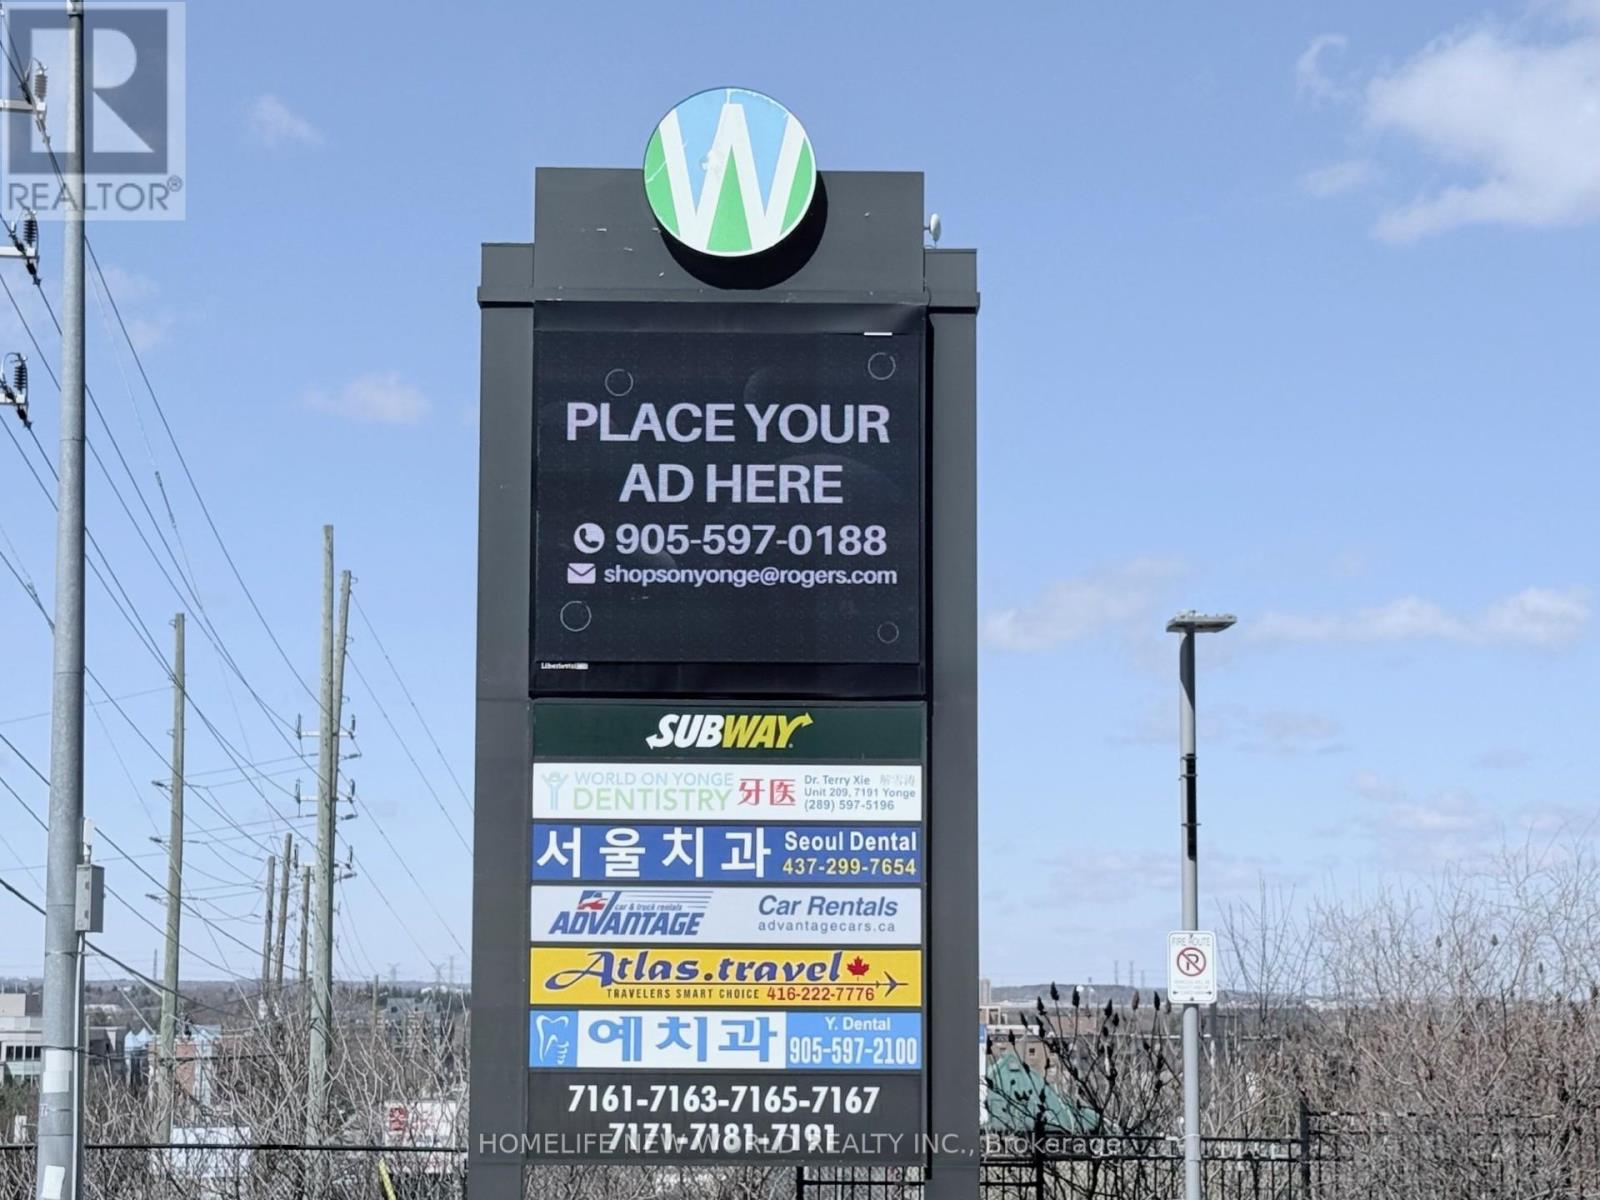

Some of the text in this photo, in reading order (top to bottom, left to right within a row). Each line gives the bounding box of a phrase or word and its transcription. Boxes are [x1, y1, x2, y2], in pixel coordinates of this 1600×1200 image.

[657, 102, 807, 255] W
[566, 402, 891, 444] PLACE YOUR
[619, 463, 844, 504] AD HERE
[615, 523, 888, 556] 905-597-0188
[603, 565, 898, 588] shopsonyonge@rogers.com
[645, 712, 813, 750] SUBWAY
[574, 772, 734, 787] WORLD ON YONGE
[737, 778, 796, 807] 牙医
[804, 774, 871, 787] Dr. Terry Xie
[572, 788, 732, 812] DENTISTRY
[804, 787, 916, 799] Unit 209, 7191 Yonge
[804, 799, 895, 812] (289) 597-5196
[536, 827, 772, 879] 서울치과
[784, 830, 917, 853] Seoul Dental
[782, 857, 917, 876] 437-299-7654
[758, 894, 899, 917] Car Rentals
[548, 908, 705, 936] ADVANTAGE
[758, 919, 896, 934] advantagecars.ca
[545, 951, 843, 990] Atlas.travel
[606, 988, 760, 1000] TRAVELERS SMART CHOICE
[766, 987, 876, 1002] 416-222-7776
[824, 1016, 891, 1032] Y. Dental
[588, 1015, 778, 1064] 예치과
[789, 1036, 918, 1066] 905-597-2100
[568, 1085, 881, 1114] 7161-7163-7165-7167
[608, 1123, 836, 1154] 7171-7181-7191
